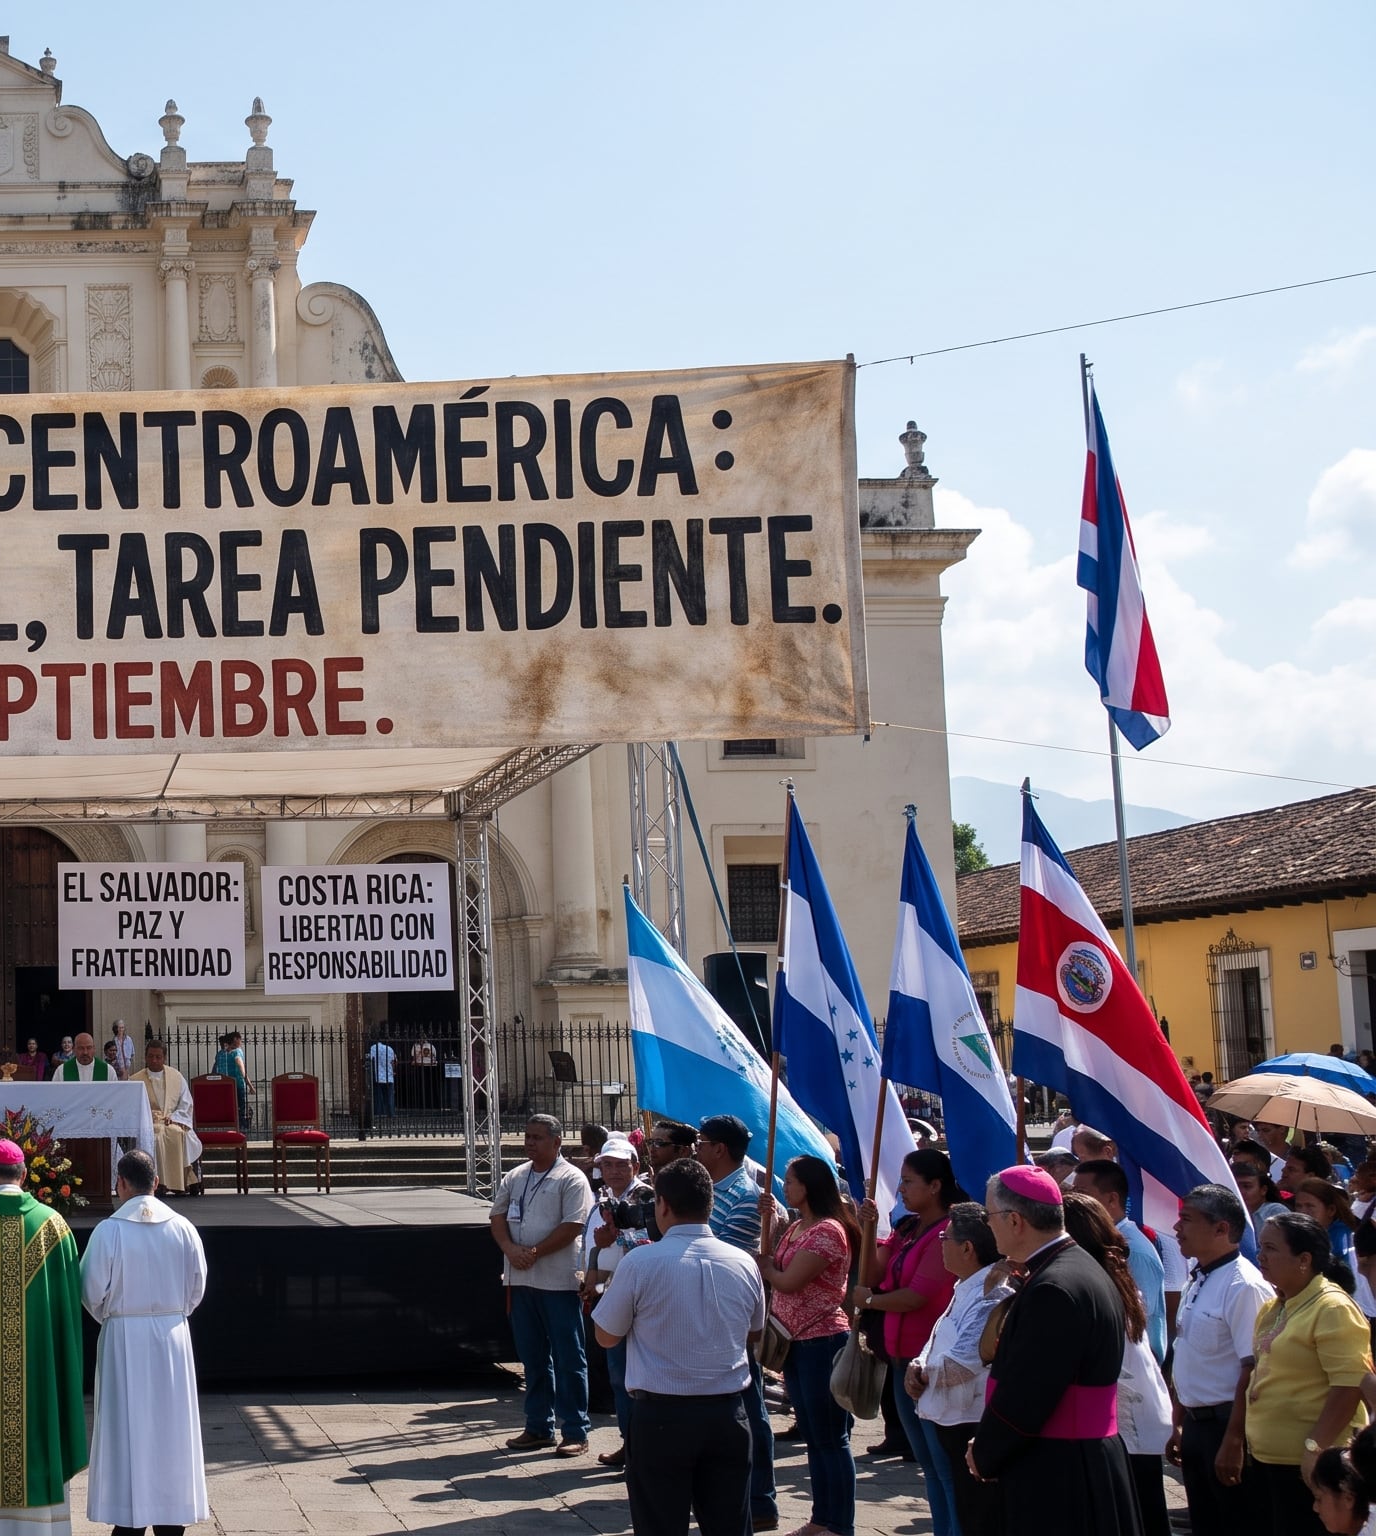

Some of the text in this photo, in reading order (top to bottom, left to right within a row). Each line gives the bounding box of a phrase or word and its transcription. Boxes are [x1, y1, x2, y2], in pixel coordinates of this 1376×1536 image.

[58, 530, 324, 639] TAREA
[359, 514, 843, 634] PENDIENTE.
[64, 872, 238, 902] EL SALVADOR:
[279, 874, 432, 906] COSTA RICA:
[119, 911, 184, 939] PAZ Y
[280, 913, 434, 942] LIBERTAD CON
[72, 948, 231, 977] FRATERNIDAD
[269, 950, 447, 980] RESPONSABILIDAD
